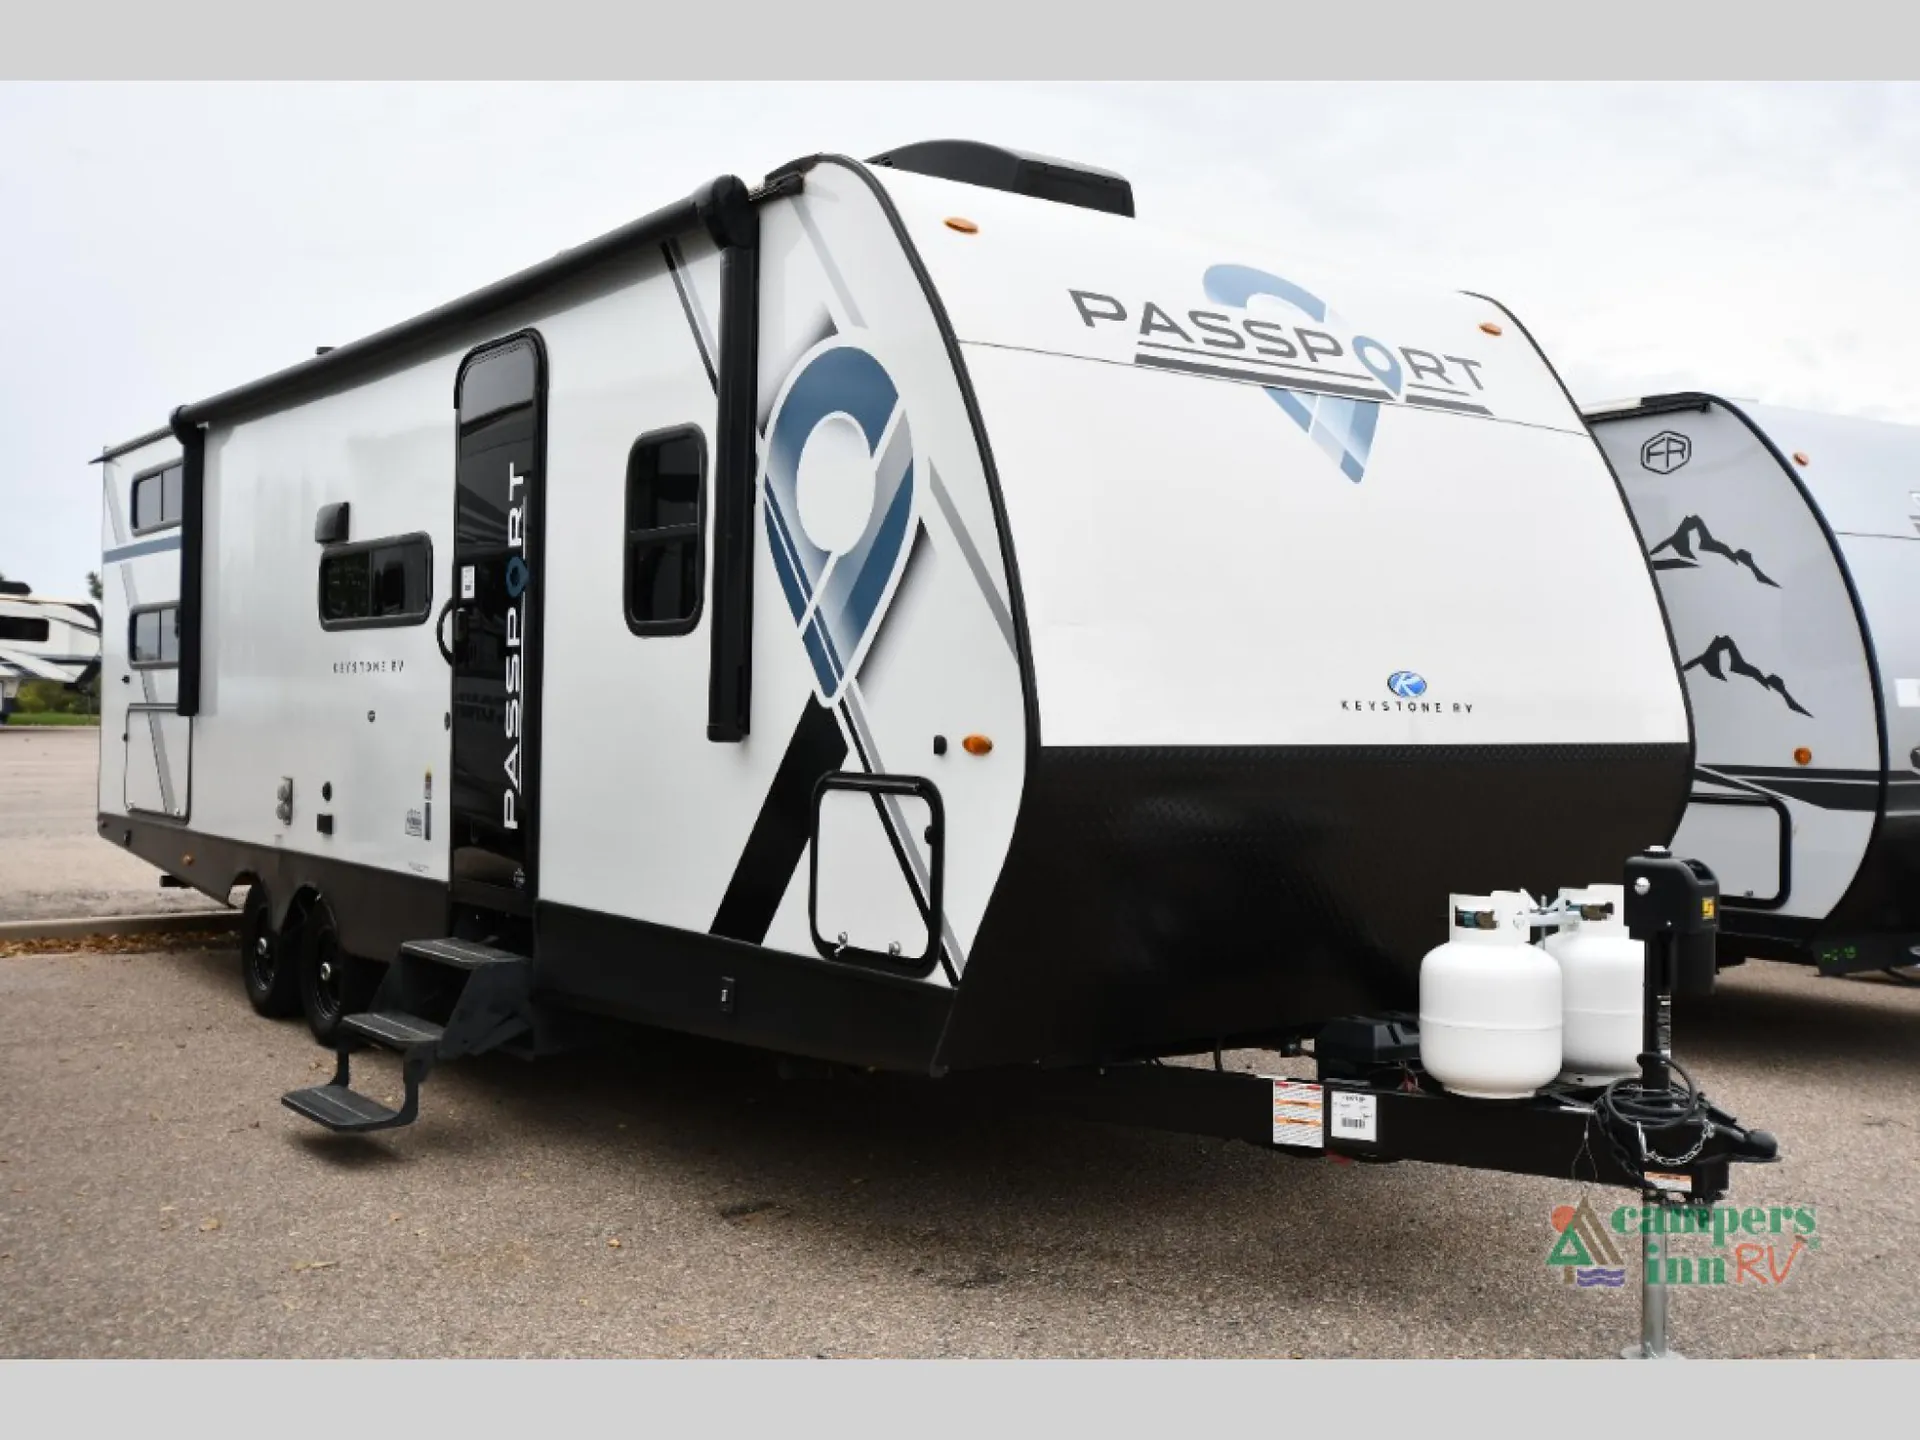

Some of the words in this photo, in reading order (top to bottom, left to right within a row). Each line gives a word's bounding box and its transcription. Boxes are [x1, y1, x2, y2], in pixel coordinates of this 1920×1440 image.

[1068, 288, 1485, 396] PASSPORT
[503, 462, 529, 830] PASSPORT
[1340, 700, 1442, 713] KEYSTONE
[1452, 702, 1473, 713] RV
